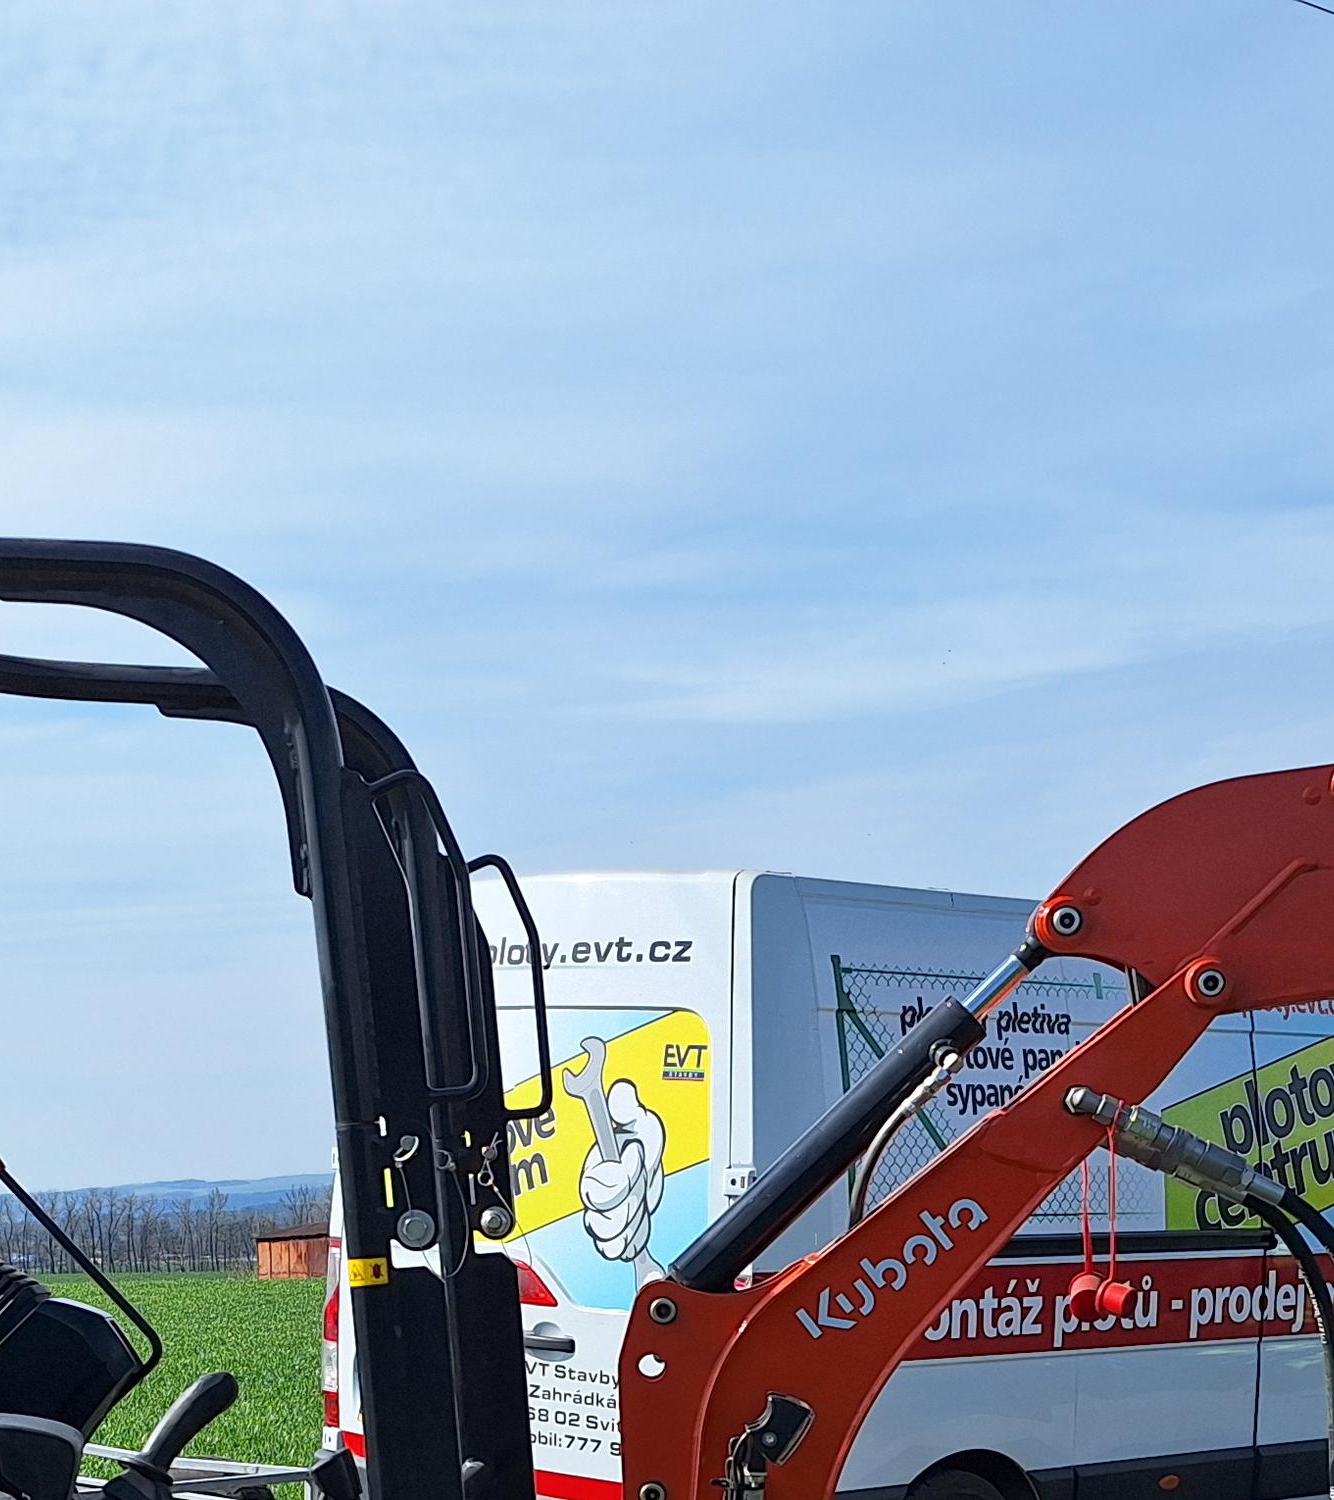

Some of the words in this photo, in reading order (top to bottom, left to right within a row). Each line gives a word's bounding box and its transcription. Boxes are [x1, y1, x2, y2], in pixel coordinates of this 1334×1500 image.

[997, 1001, 1071, 1040] pletiva
[663, 1044, 708, 1068] EVT
[795, 1198, 990, 1340] Kubota
[1189, 1268, 1307, 1340] prodej
[526, 1361, 550, 1376] VT
[554, 1364, 619, 1389] Stavby
[529, 1384, 617, 1409] Zahrádká
[555, 1411, 580, 1427] 02
